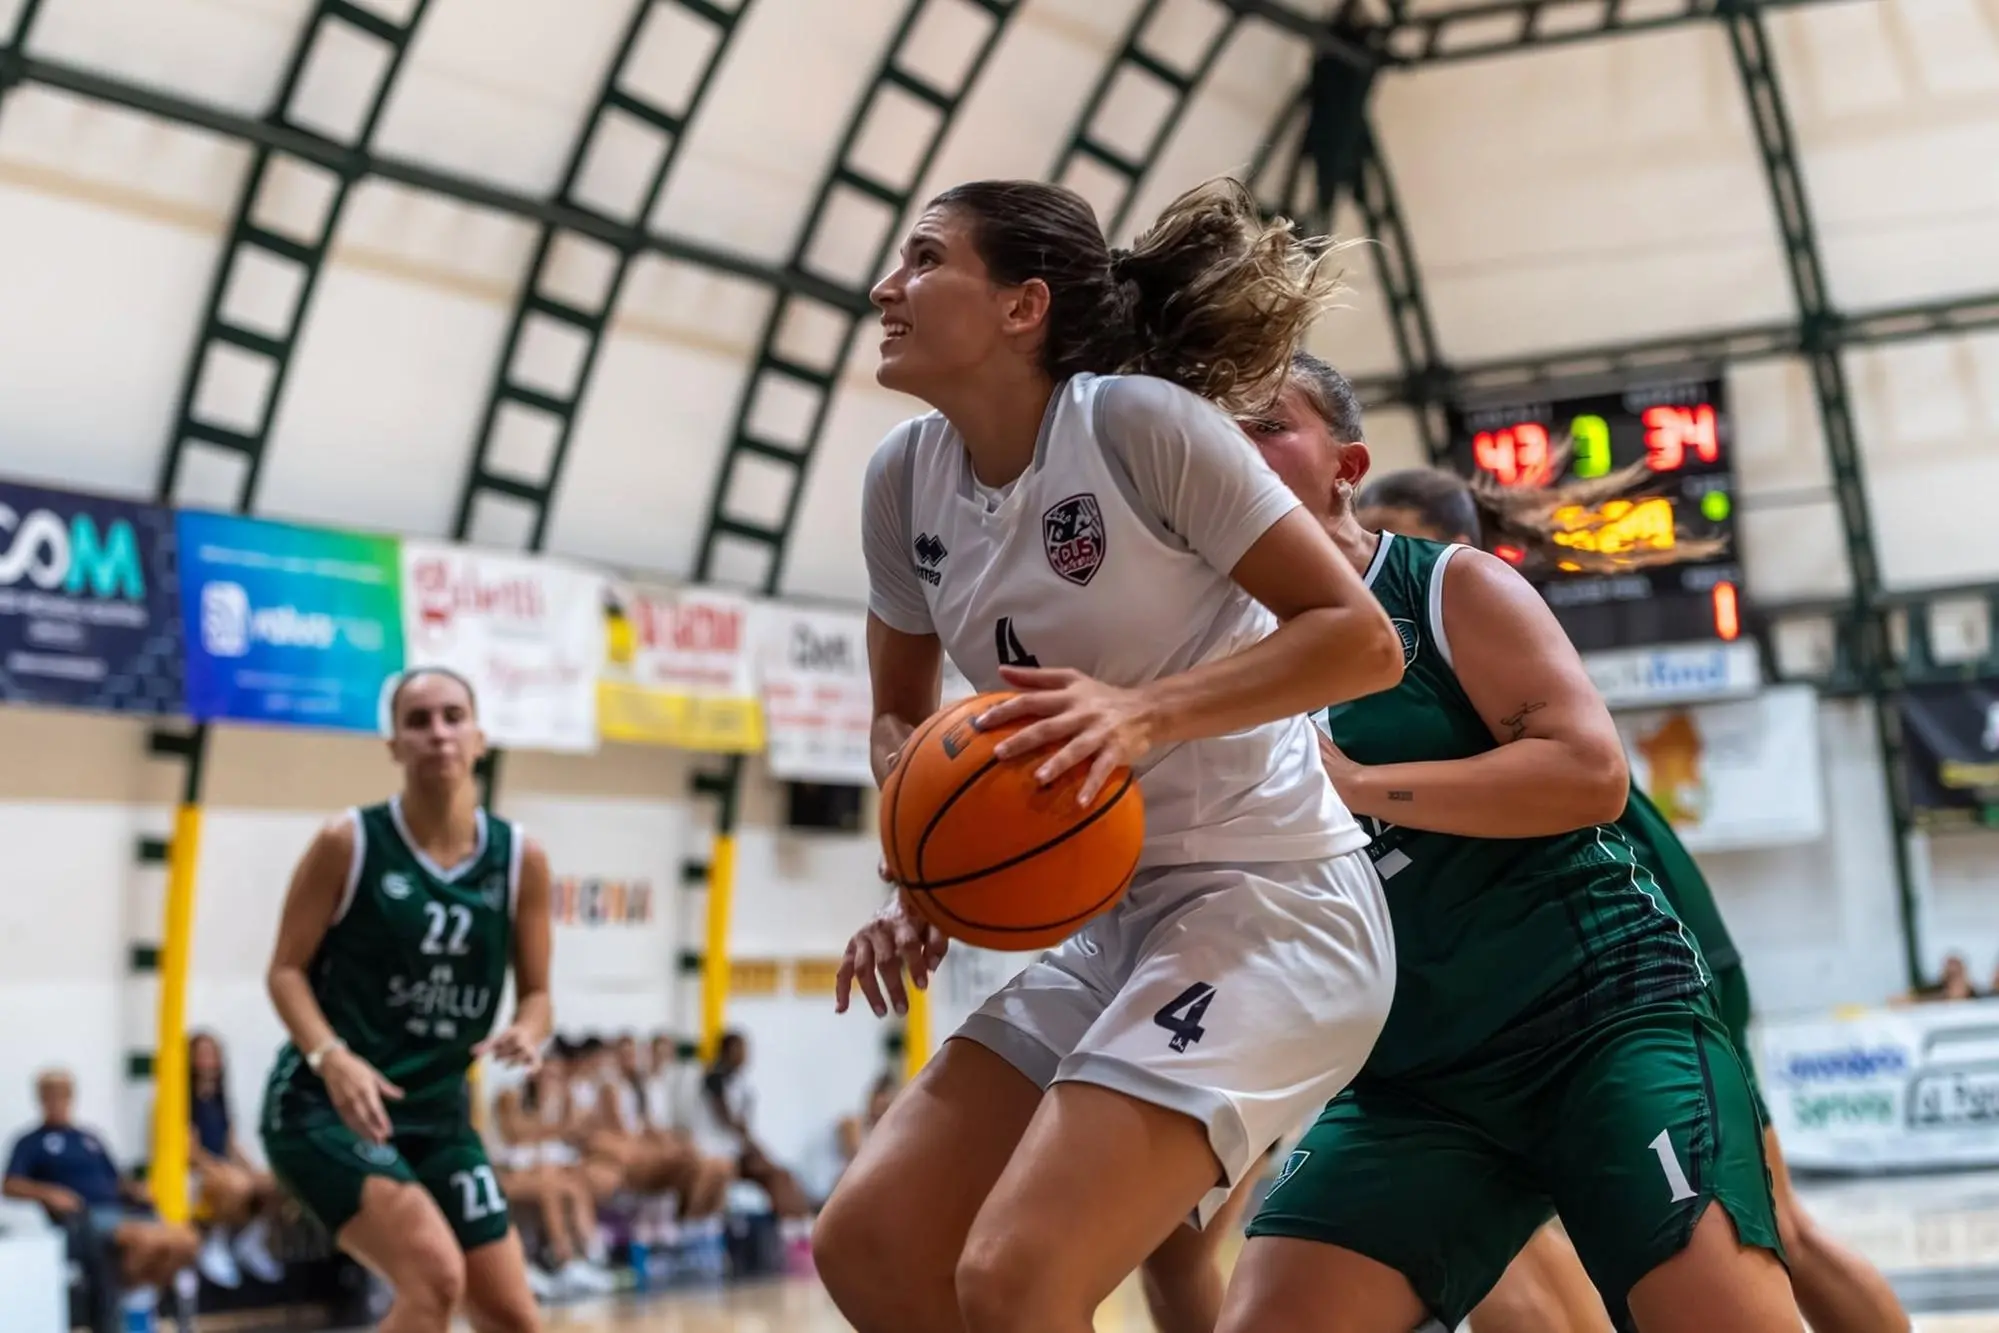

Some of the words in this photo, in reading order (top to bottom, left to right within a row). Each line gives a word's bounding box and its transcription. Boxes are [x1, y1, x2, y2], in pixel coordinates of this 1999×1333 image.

[1473, 422, 1550, 485] 43
[1641, 404, 1718, 472] 34
[1712, 580, 1740, 641] 1
[995, 616, 1041, 669] 4
[420, 901, 474, 956] 22
[1153, 981, 1218, 1054] 4
[1647, 1128, 1699, 1204] 1
